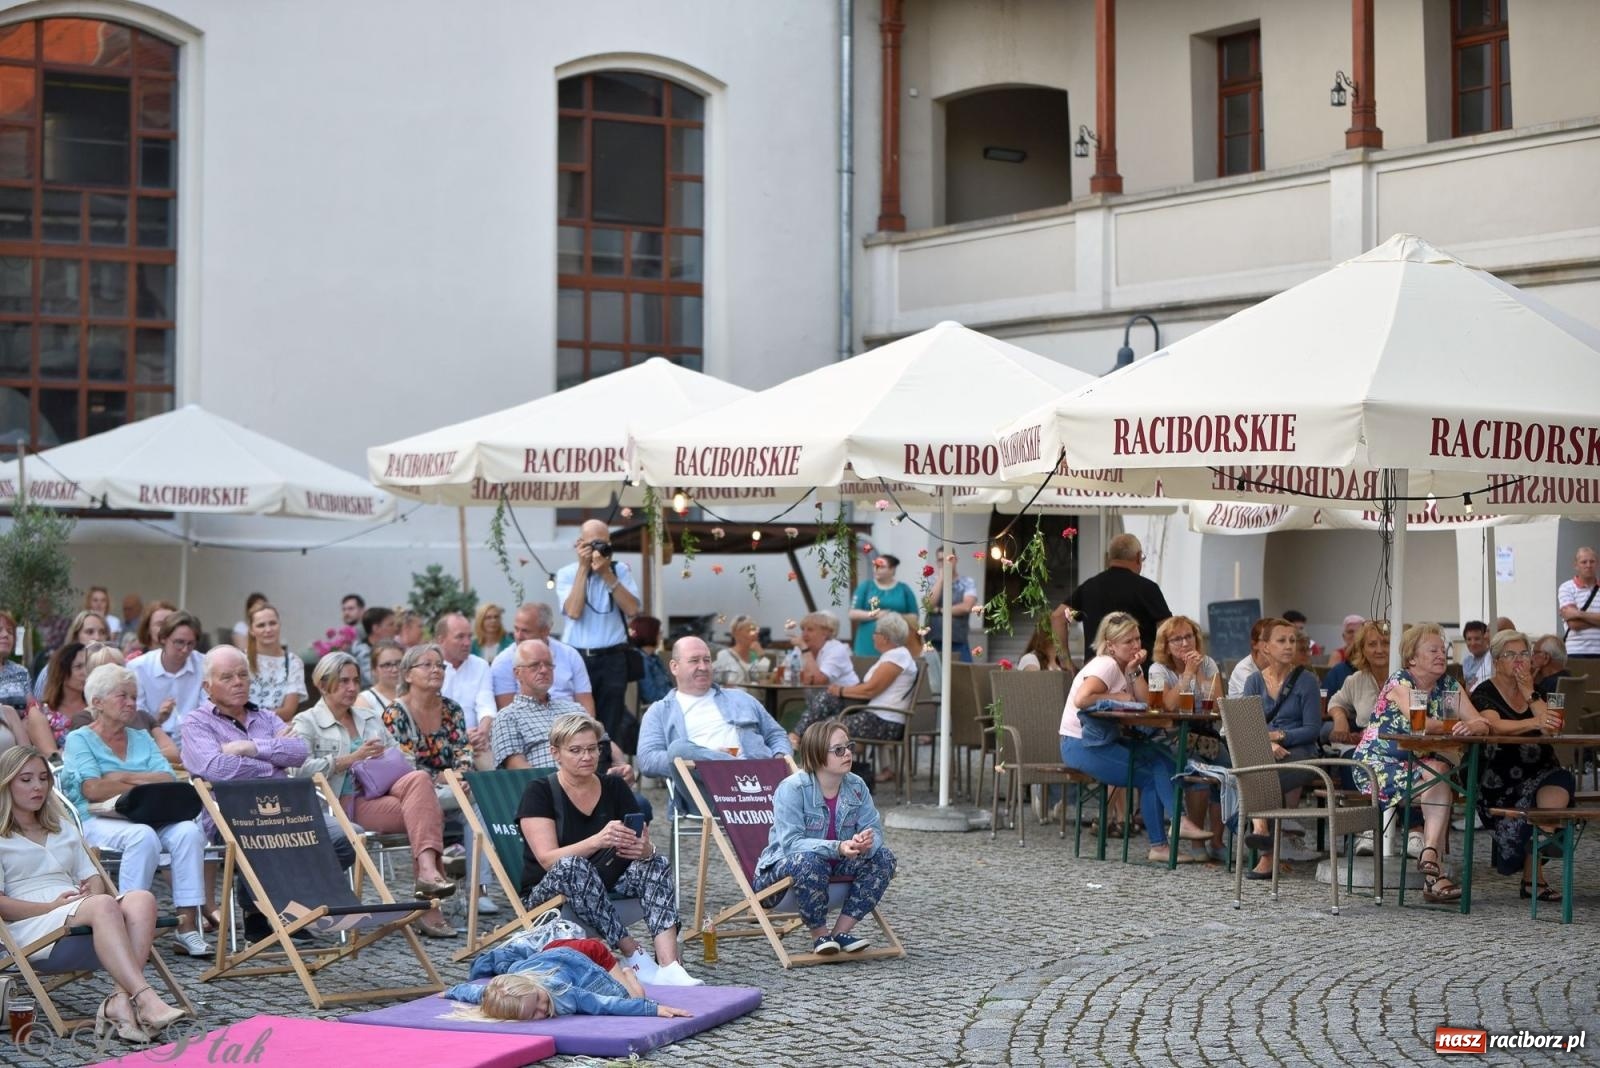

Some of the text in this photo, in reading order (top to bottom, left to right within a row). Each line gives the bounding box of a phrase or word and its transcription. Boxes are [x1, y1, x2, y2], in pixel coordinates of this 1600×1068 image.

[1113, 414, 1297, 456] RACIBORSKIE
[384, 450, 458, 478] RACIBORSKIE
[674, 445, 803, 477] RACIBORSKIE
[139, 484, 249, 507] RACIBORSKIE
[232, 818, 255, 826] Browar
[256, 817, 285, 826] Zamkowy
[492, 823, 518, 835] MAS
[240, 830, 319, 850] RACIBORSKIE
